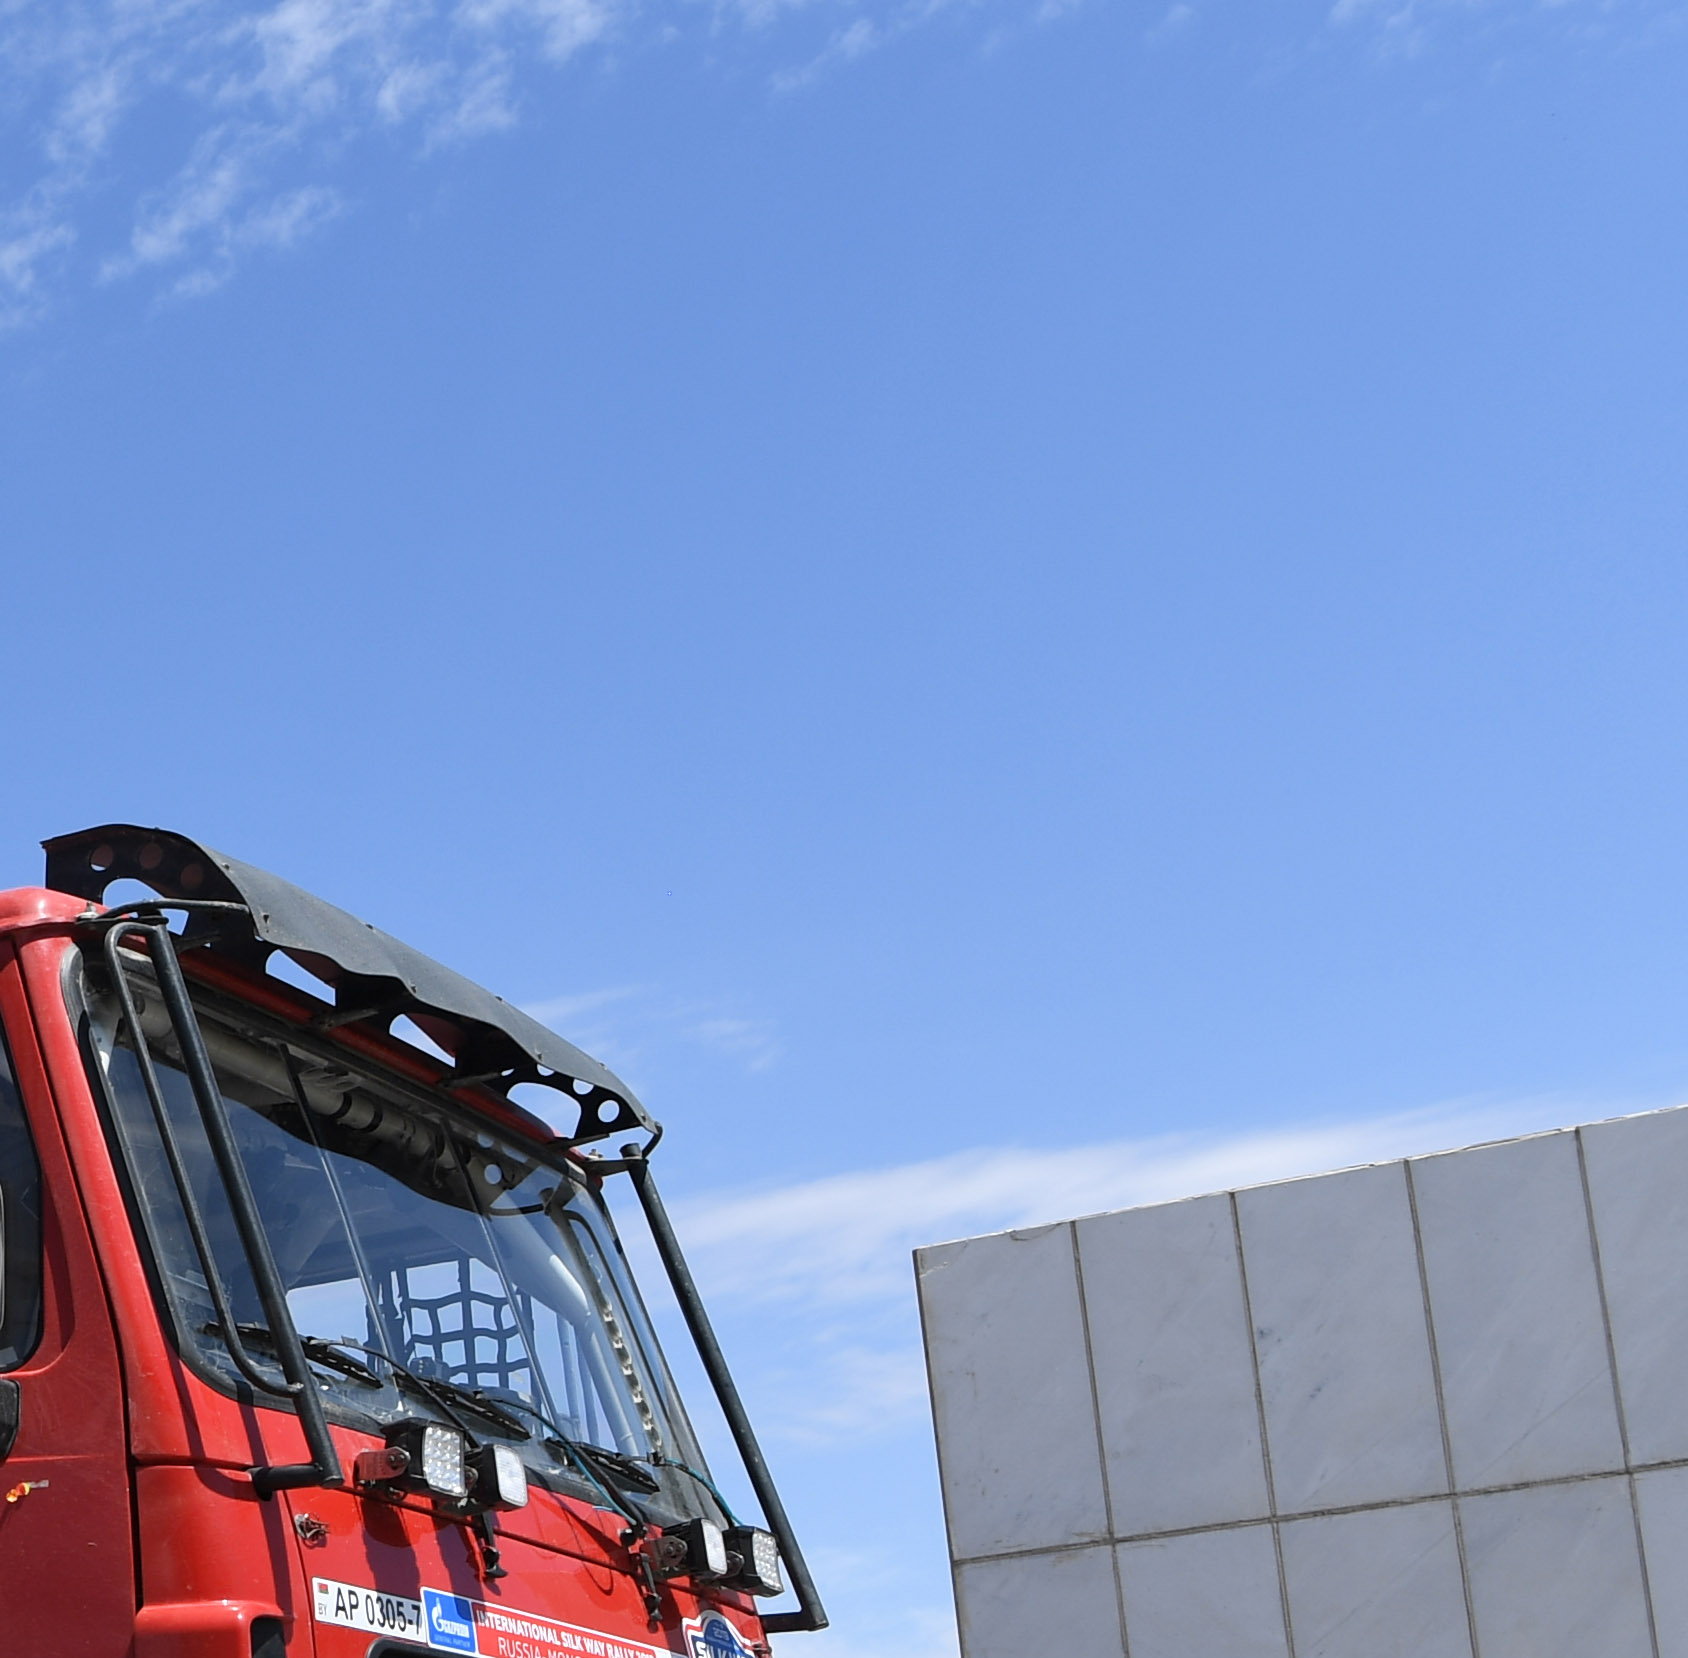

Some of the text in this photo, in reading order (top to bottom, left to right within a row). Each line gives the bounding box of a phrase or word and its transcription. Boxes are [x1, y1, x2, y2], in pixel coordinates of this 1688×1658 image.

[335, 1587, 423, 1635] AP 0305-7
[476, 1610, 559, 1644] INTERNATIONAL
[561, 1631, 583, 1650] SILK
[584, 1637, 606, 1658] WAY
